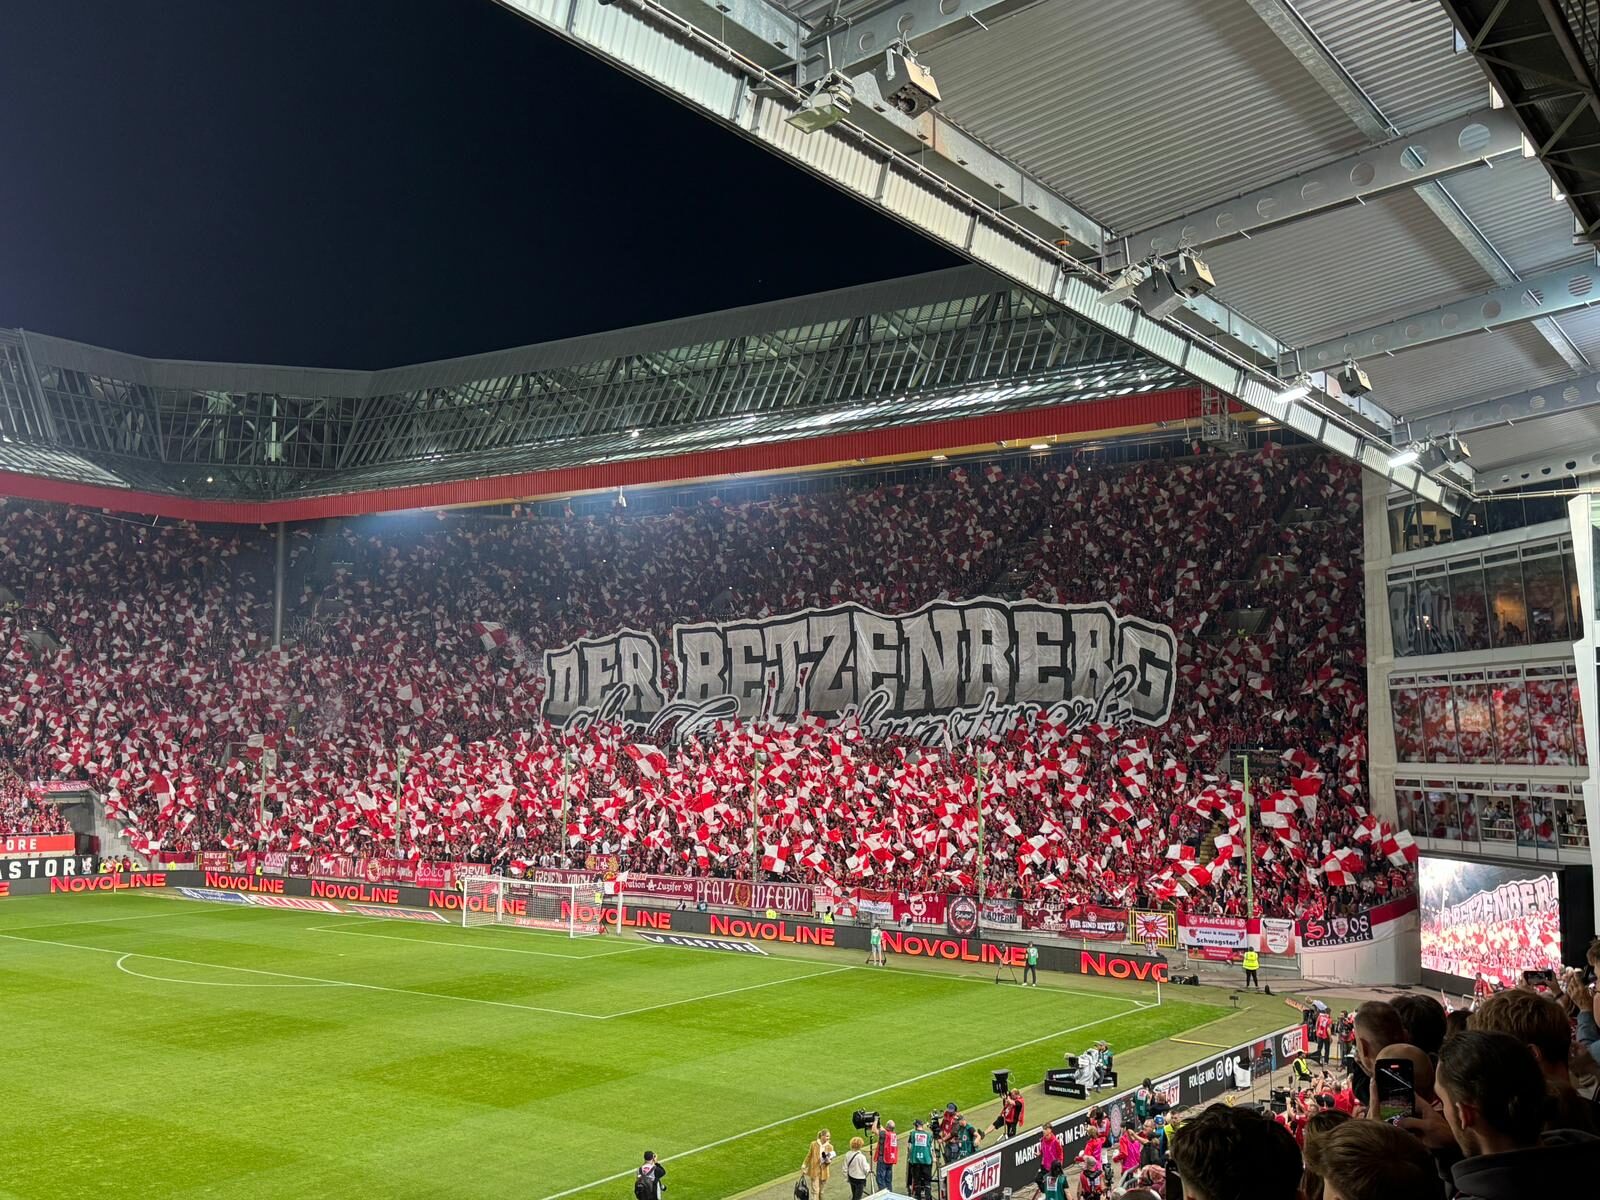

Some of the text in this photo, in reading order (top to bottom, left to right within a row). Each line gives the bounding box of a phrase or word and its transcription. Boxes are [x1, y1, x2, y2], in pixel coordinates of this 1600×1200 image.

[544, 602, 1177, 725] DER BETZENBERG
[0, 839, 37, 850] ORE
[0, 858, 76, 880] STOR
[696, 880, 810, 912] PFALZ INFERNO
[669, 936, 760, 953] CASTORE
[1307, 931, 1371, 947] Grünstadt
[973, 1162, 1000, 1195] DART
